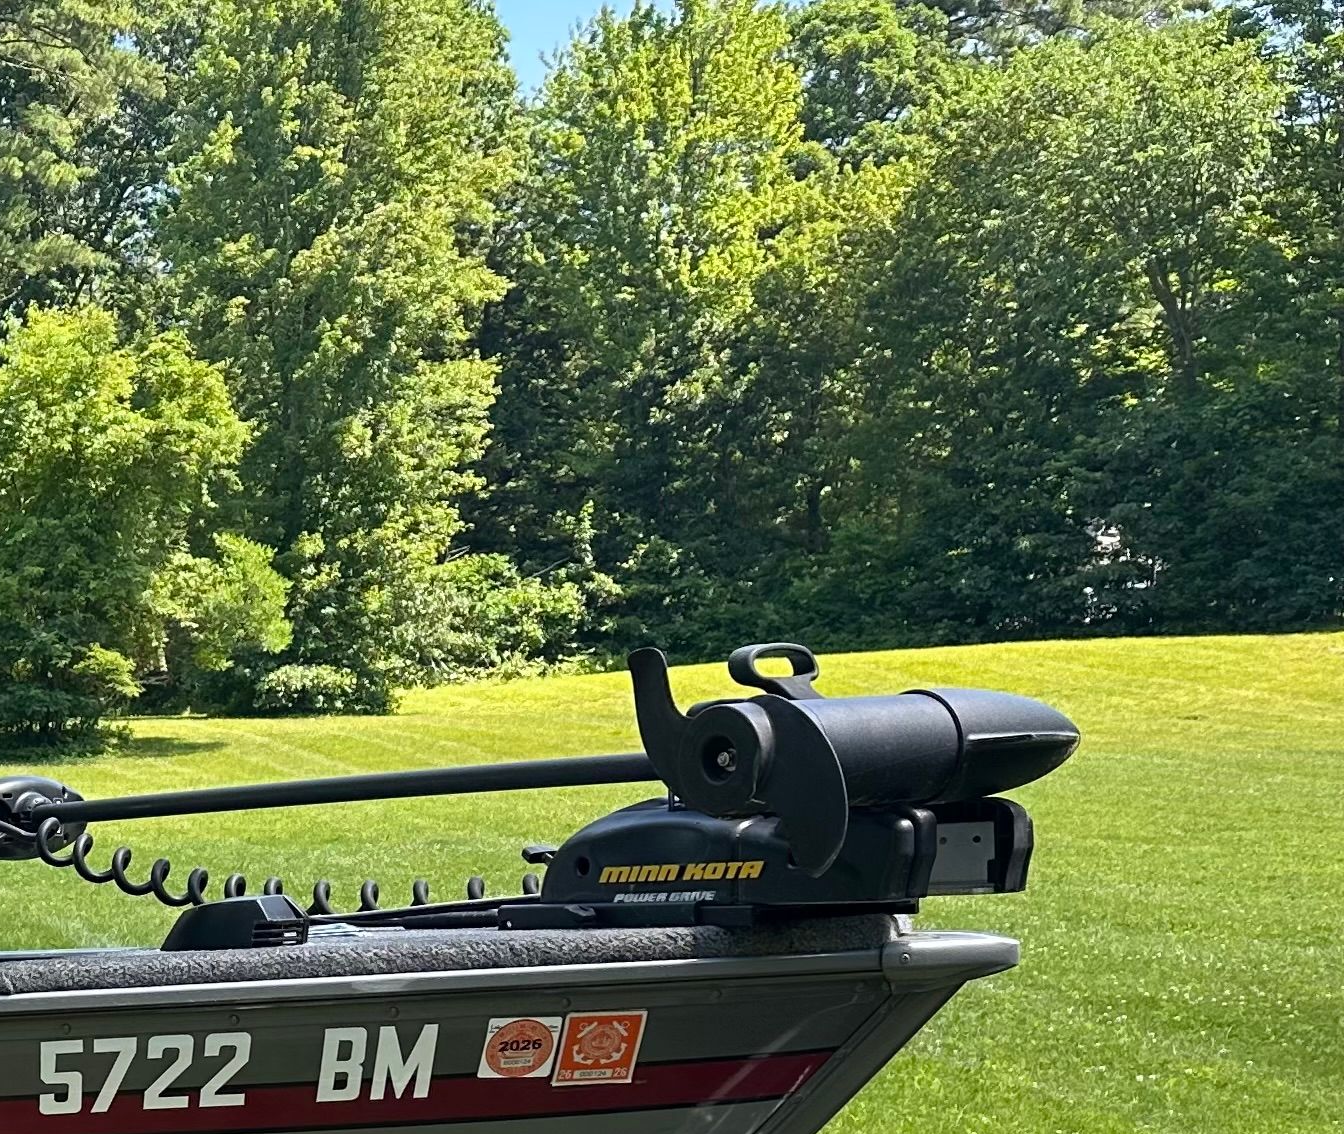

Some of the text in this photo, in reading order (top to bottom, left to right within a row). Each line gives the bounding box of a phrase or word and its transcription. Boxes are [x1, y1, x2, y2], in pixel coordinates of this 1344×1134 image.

[599, 861, 764, 883] MINN KOTA
[614, 891, 716, 903] POWER DRIVE
[498, 1039, 542, 1052] 2026
[39, 1031, 252, 1115] 5722
[315, 1024, 439, 1103] BM
